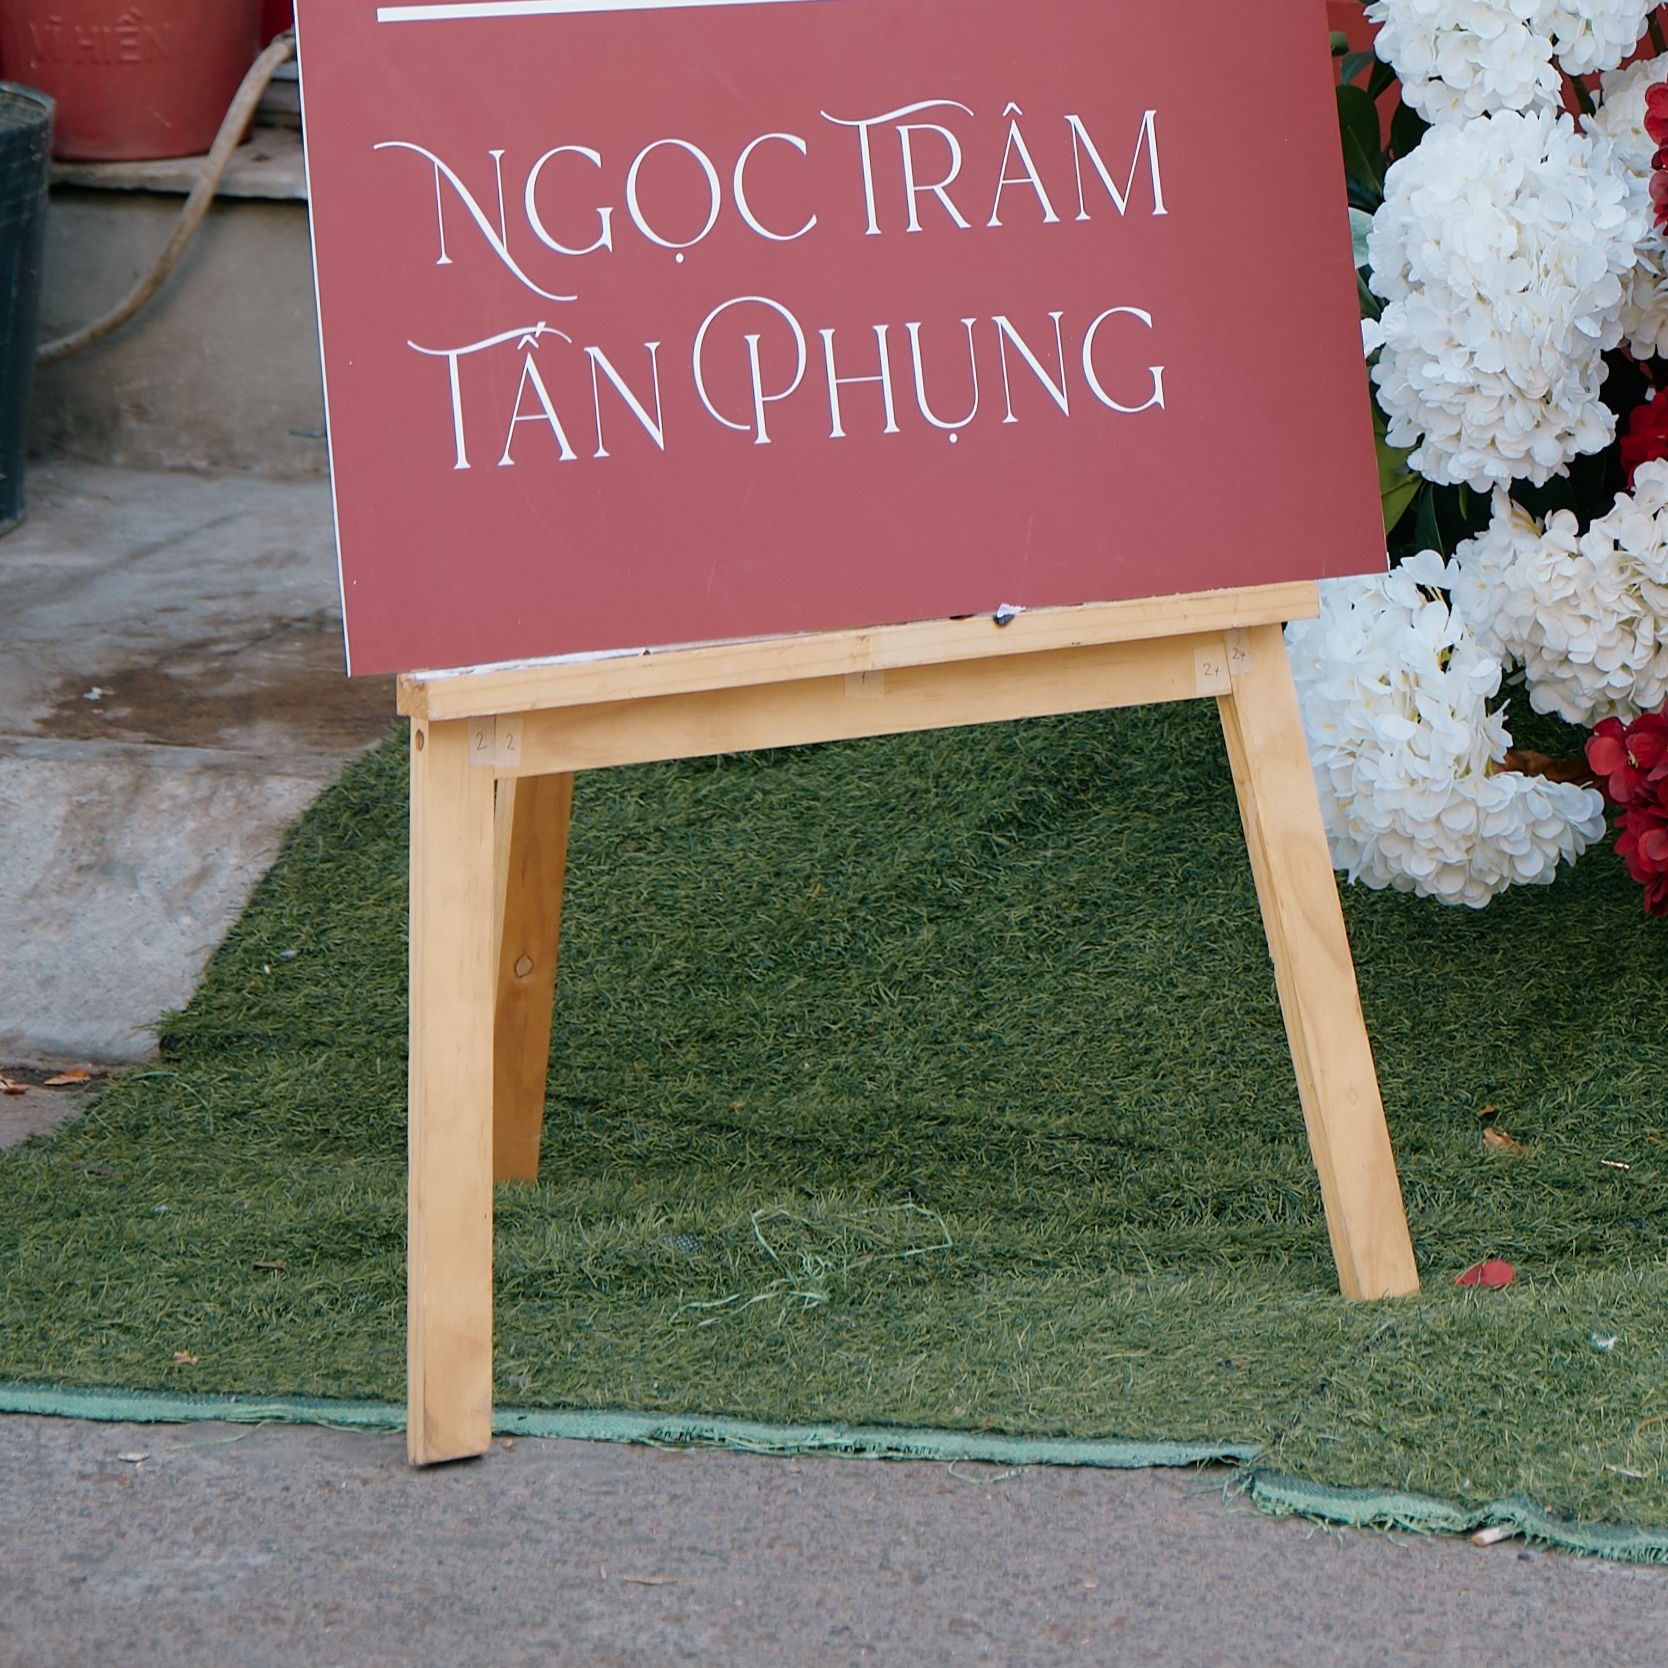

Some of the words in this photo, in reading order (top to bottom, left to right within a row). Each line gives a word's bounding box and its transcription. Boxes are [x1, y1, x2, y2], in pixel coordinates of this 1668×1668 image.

[374, 133, 818, 303] NGỌC
[820, 99, 1169, 237] TRÂM
[407, 320, 666, 471] TẤN
[693, 295, 1166, 446] PHỤNG
